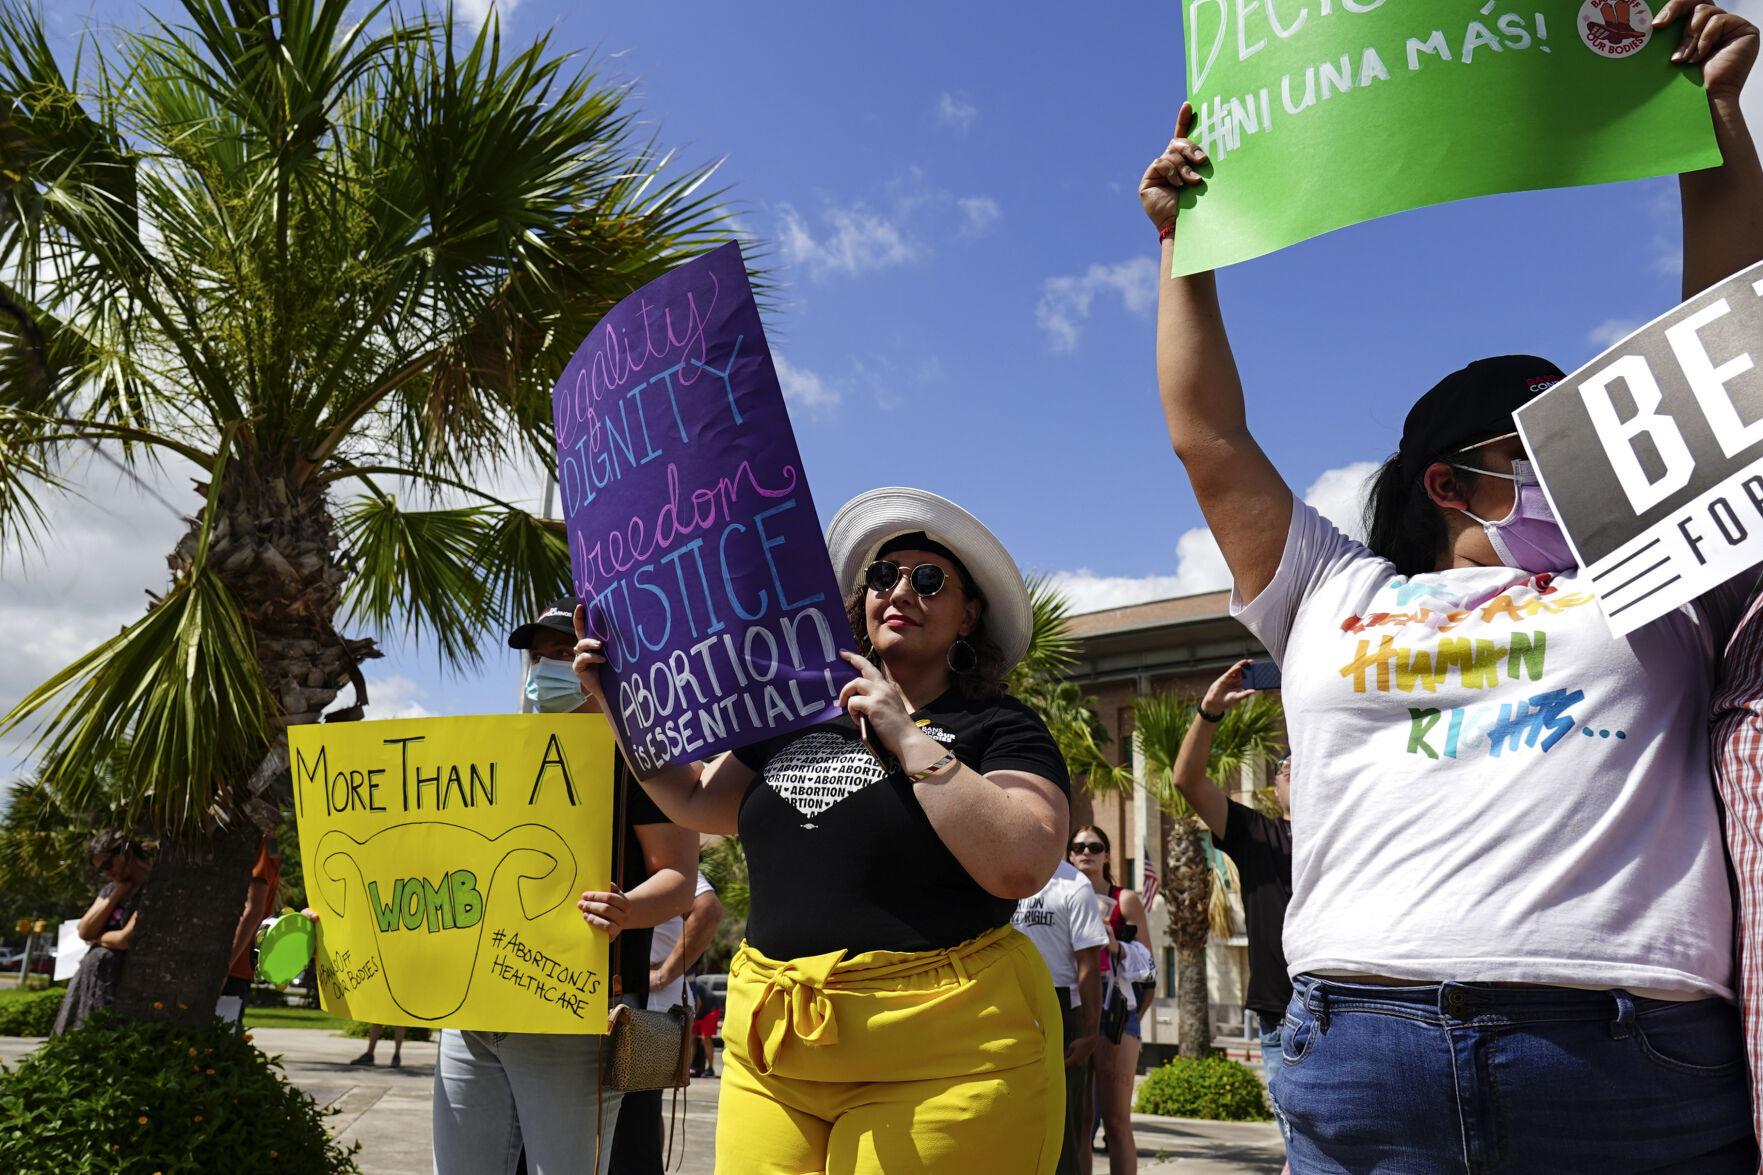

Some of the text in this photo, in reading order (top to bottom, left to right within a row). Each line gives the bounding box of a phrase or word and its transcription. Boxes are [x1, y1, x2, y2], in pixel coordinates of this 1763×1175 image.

[1281, 47, 1391, 115] UNA
[1406, 0, 1552, 71] MÁS!
[1586, 33, 1644, 54] OUR BODIES
[563, 334, 744, 518] DIGNITY
[1577, 282, 1763, 516] BE
[575, 461, 796, 642] freedom
[590, 499, 825, 673] JUSTICE
[646, 668, 843, 769] ESSENTIAL!
[937, 732, 956, 740] OUR
[296, 733, 582, 818] MORE THAN A
[765, 774, 873, 787] ORTION ABORTION
[779, 764, 831, 774] ABORTION
[790, 786, 845, 798] ABORTION
[801, 756, 856, 764] ABORTION
[368, 869, 483, 934] WOMB
[333, 956, 379, 1000] OUR BODIES
[491, 954, 589, 1019] HEALTHCARE
